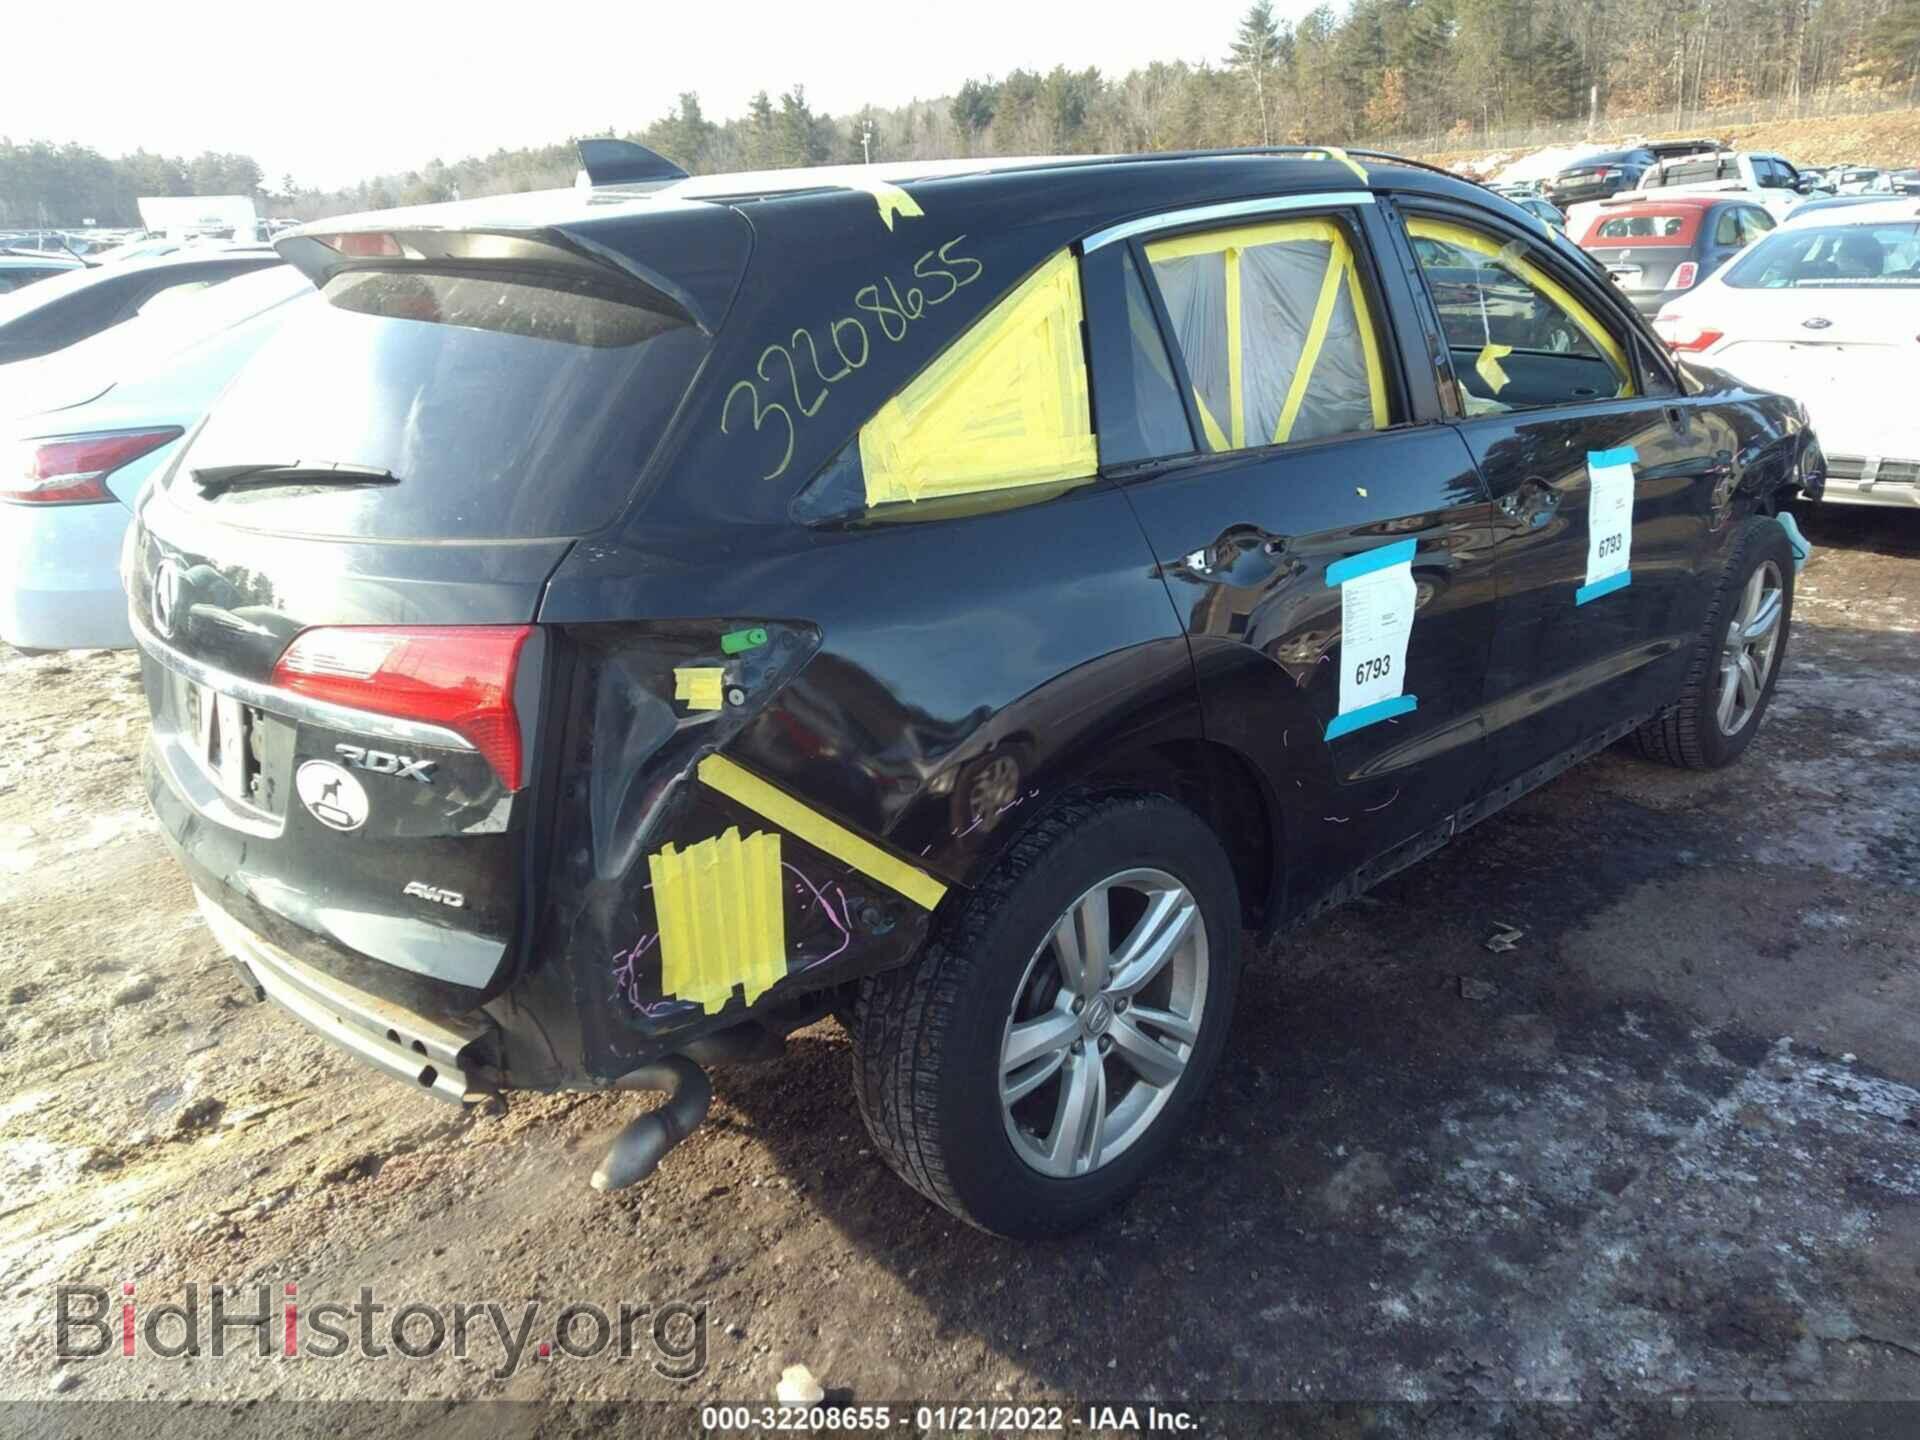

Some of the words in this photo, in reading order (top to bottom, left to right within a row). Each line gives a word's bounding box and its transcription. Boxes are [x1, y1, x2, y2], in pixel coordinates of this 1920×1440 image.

[721, 234, 983, 481] 32208655
[1598, 533, 1622, 559] 6793
[1355, 654, 1391, 686] 6793
[335, 743, 436, 784] RDX
[403, 881, 465, 908] AWD
